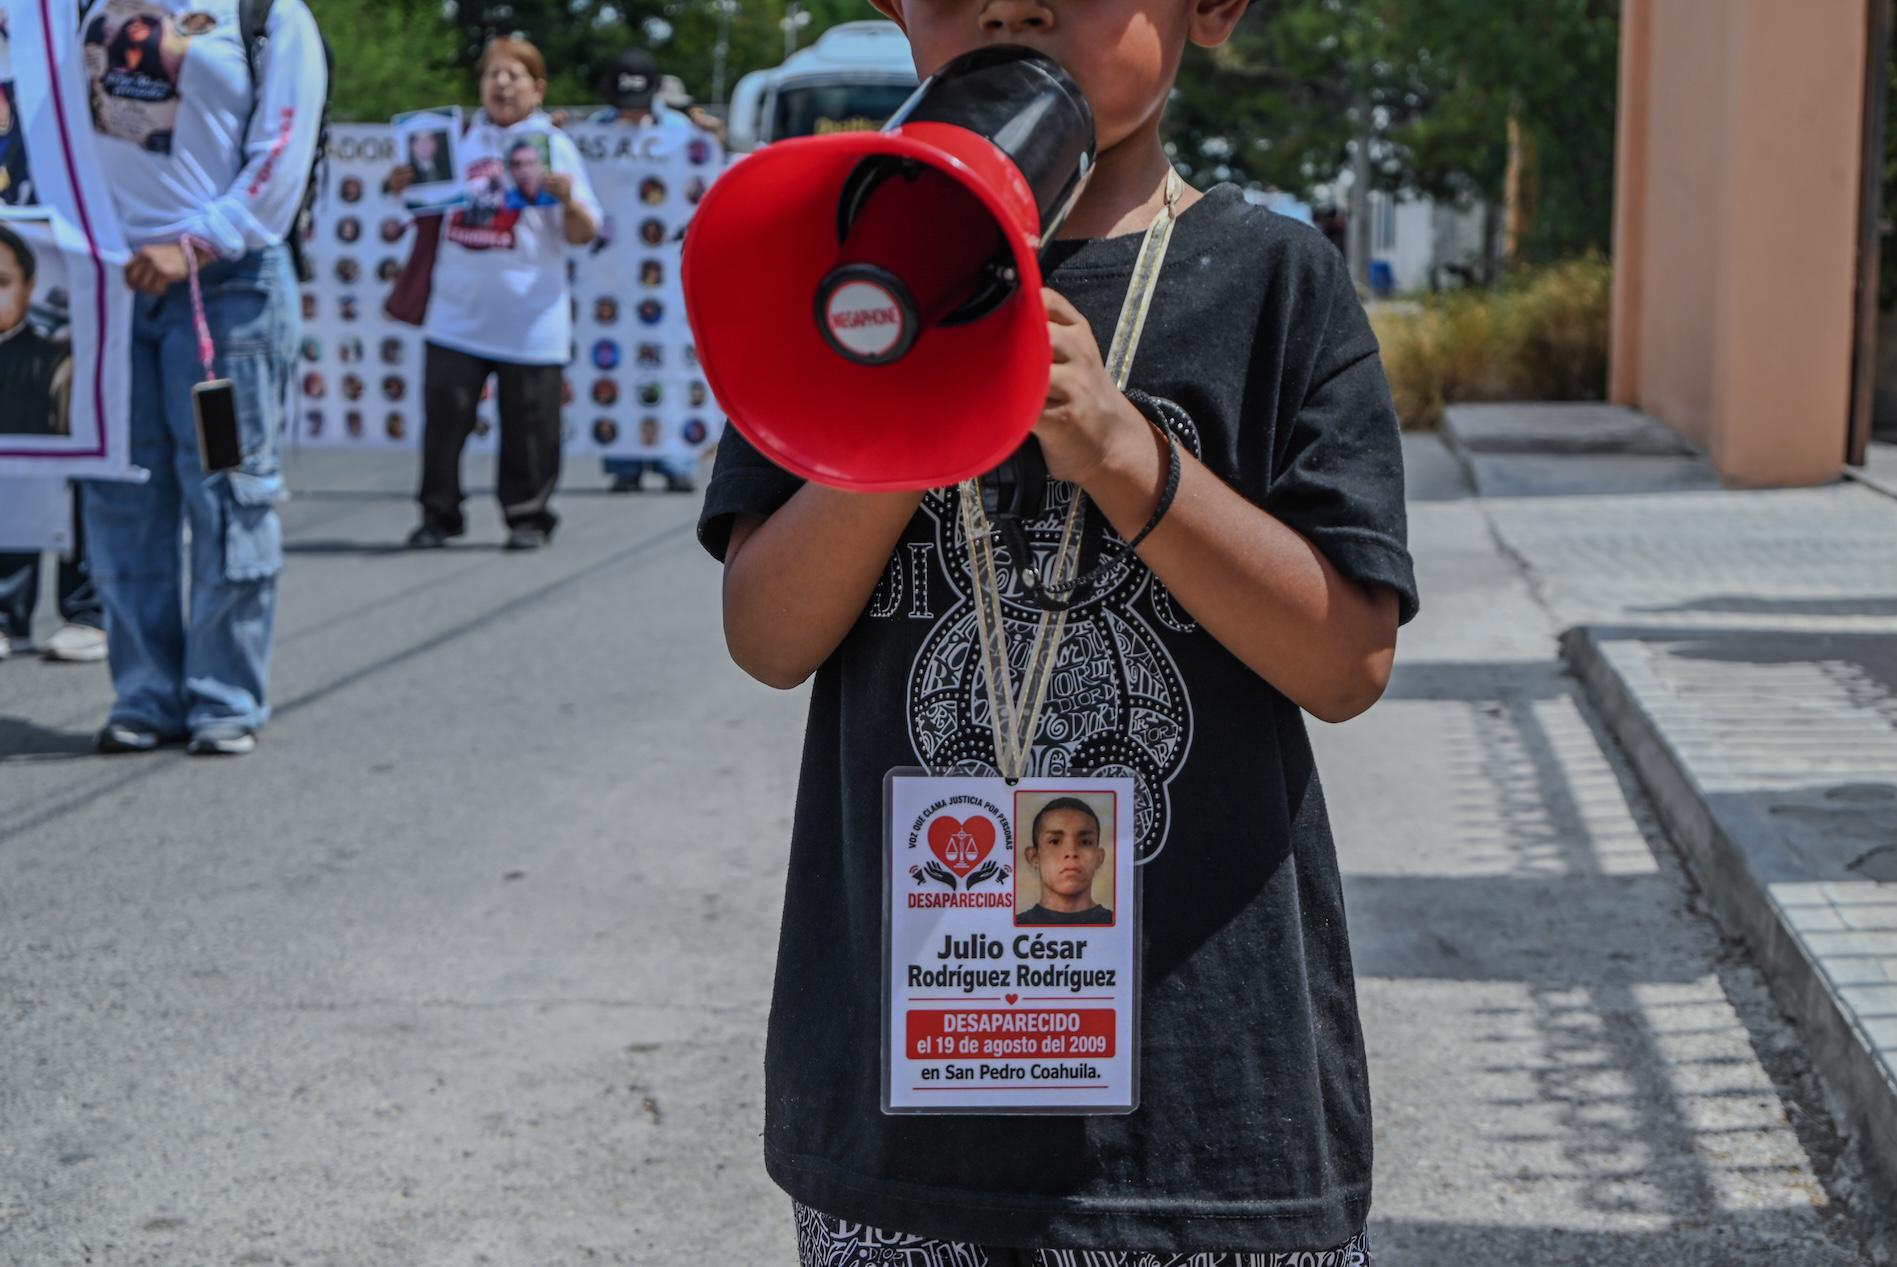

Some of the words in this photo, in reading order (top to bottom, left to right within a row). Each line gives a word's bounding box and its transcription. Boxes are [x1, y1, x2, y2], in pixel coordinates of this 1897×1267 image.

[923, 799, 947, 818] CLAMA
[949, 795, 983, 807] JUSTICIA
[984, 801, 999, 816] POR
[913, 815, 926, 831] QUE
[996, 813, 1013, 850] PERSONAS
[908, 832, 919, 849] VOZ
[908, 893, 1012, 909] DESAPARECIDAS
[938, 934, 1004, 960] Julio
[1012, 933, 1088, 960] César
[907, 965, 1011, 993] Rodríguez
[1016, 964, 1116, 992] Rodríguez
[943, 1013, 1081, 1033] DESAPARECIDO
[916, 1036, 931, 1054] el
[937, 1036, 955, 1054] 19
[959, 1036, 979, 1054] de
[983, 1037, 1037, 1057] agosto
[1041, 1036, 1065, 1053] del
[1069, 1036, 1107, 1053] 2009
[920, 1067, 940, 1081] en
[945, 1065, 974, 1080] San
[980, 1064, 1026, 1080] Pedro
[1030, 1063, 1102, 1080] Coahuila.
